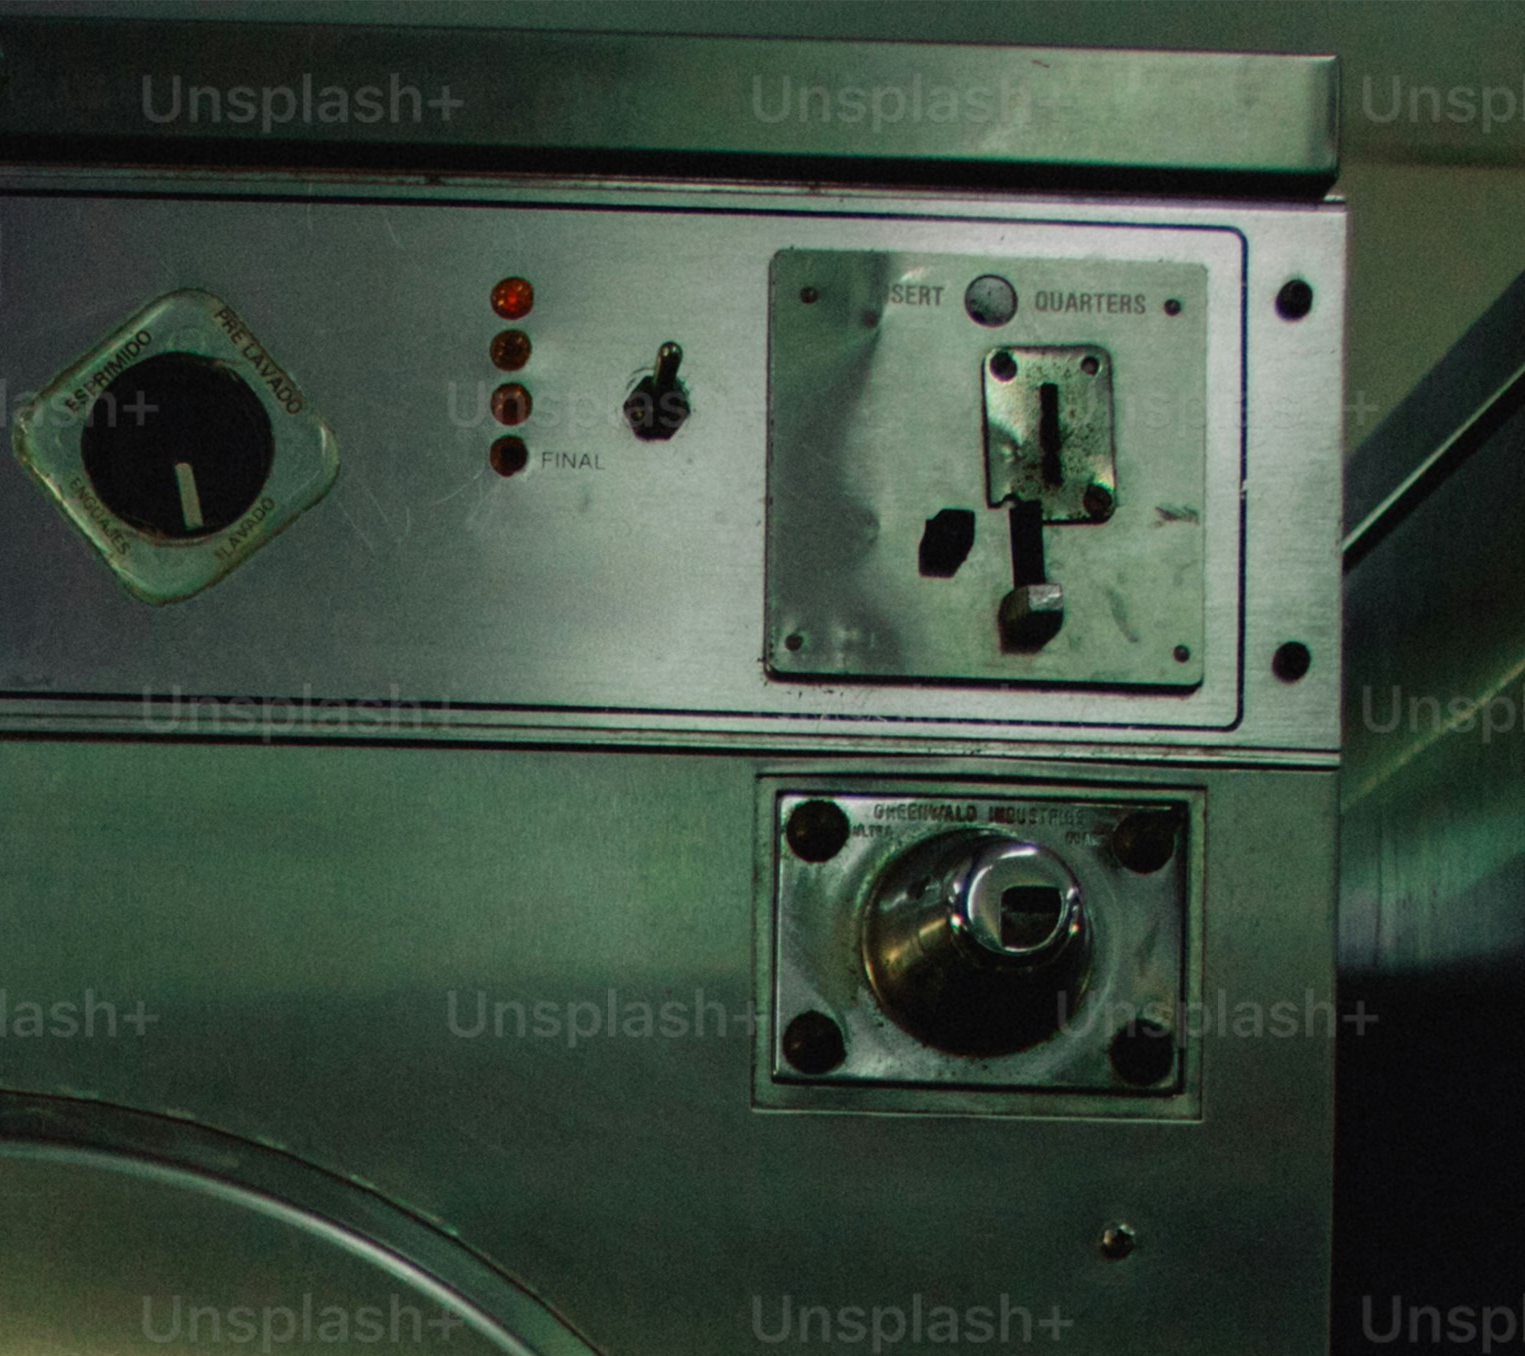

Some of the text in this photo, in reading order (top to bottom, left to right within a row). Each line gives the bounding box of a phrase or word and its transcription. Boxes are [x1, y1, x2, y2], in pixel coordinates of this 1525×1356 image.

[1034, 290, 1147, 315] QUARTERS
[64, 330, 152, 412] ESPRIMIDO
[214, 307, 303, 415] PRE LAVADO
[541, 451, 606, 470] FINAL
